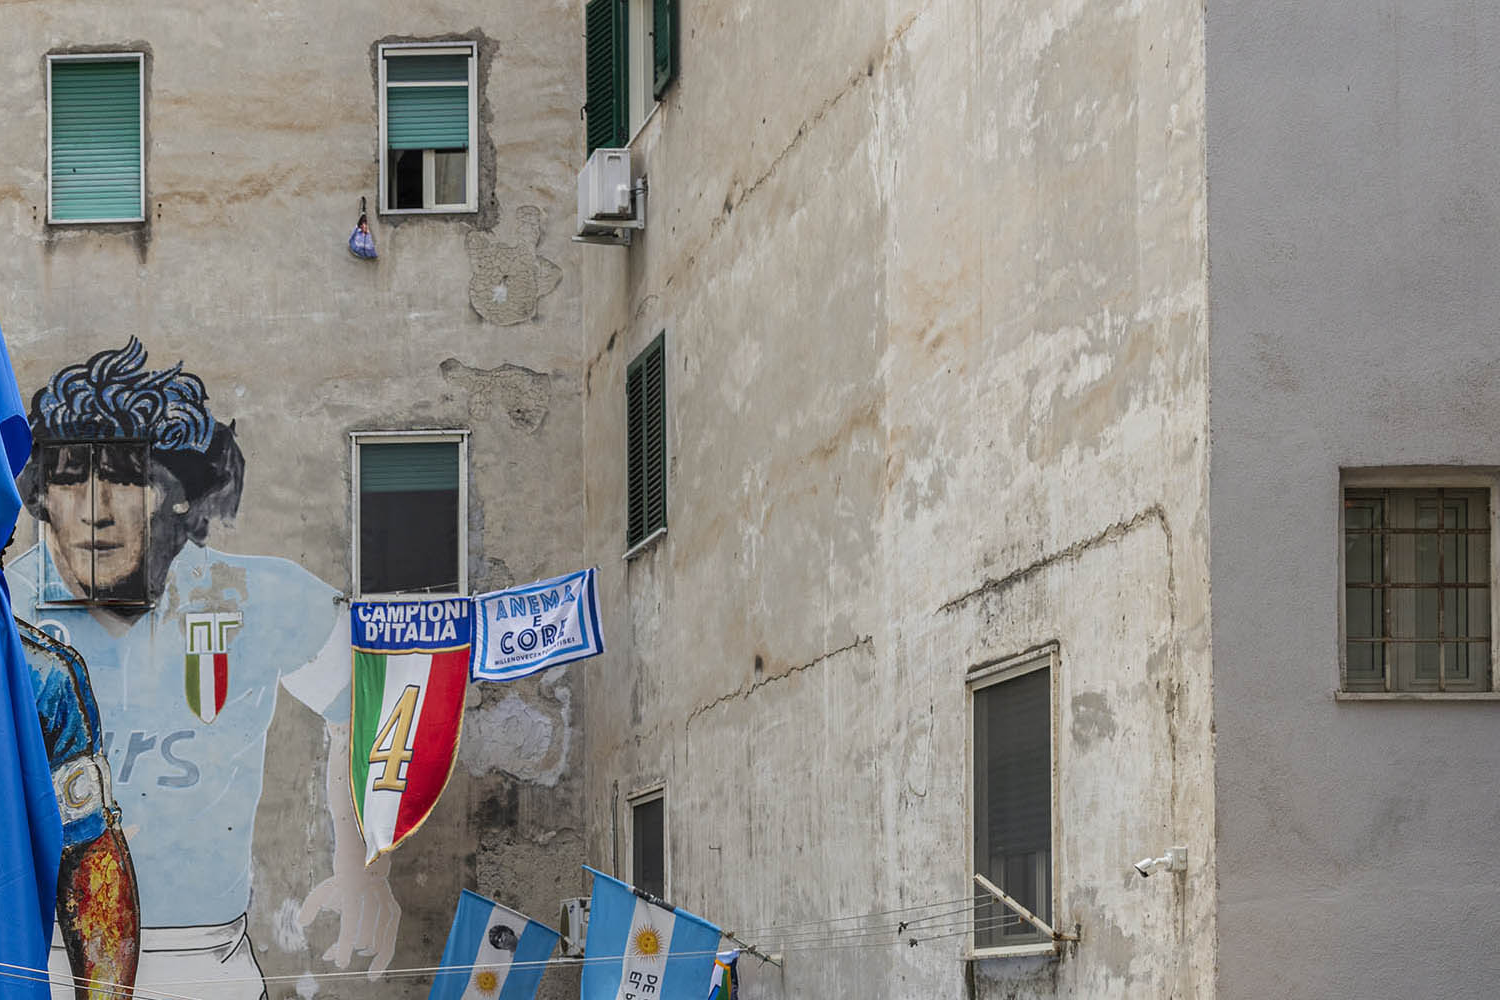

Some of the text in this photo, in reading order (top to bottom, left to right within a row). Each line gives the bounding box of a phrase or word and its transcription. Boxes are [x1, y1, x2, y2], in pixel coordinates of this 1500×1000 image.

[357, 600, 468, 623] CAMPIONI
[495, 584, 576, 621] ANEMA
[365, 620, 457, 643] D'ITALIA
[533, 615, 542, 627] E
[368, 684, 421, 792] 4
